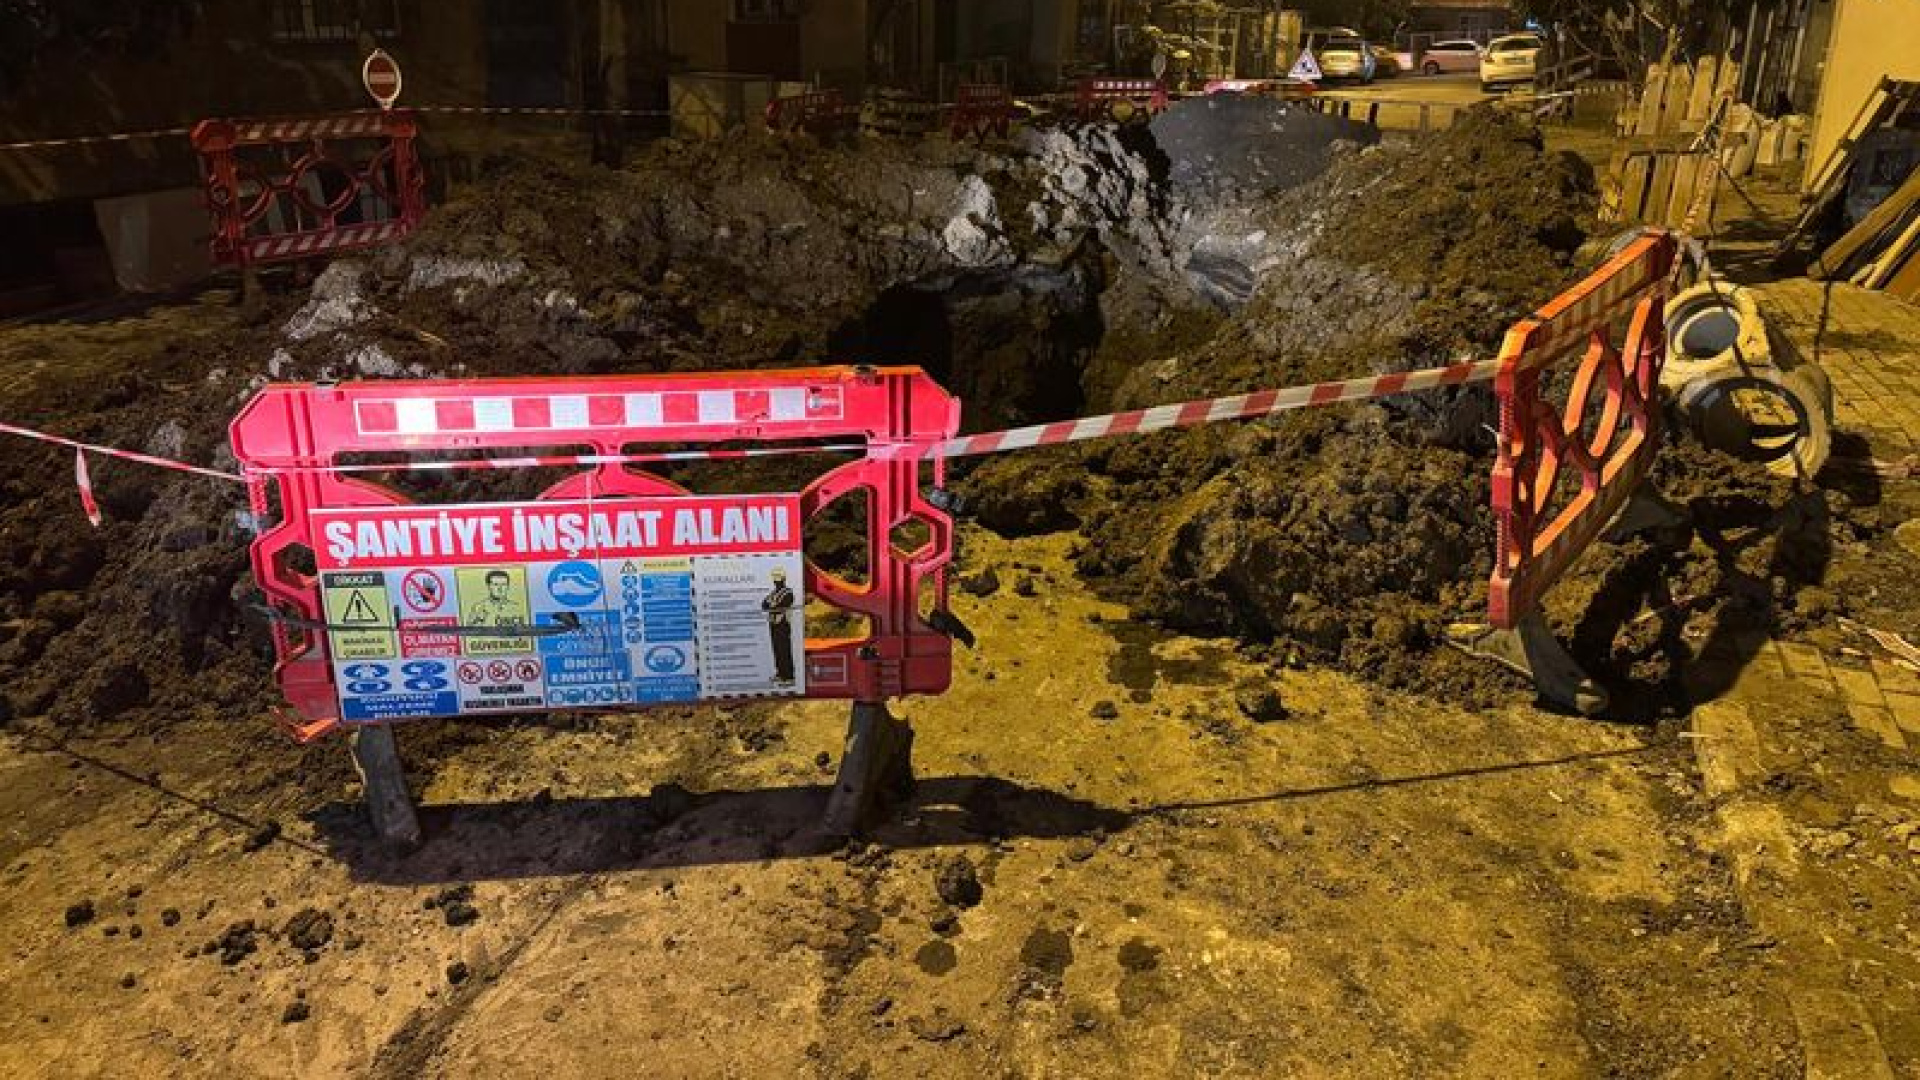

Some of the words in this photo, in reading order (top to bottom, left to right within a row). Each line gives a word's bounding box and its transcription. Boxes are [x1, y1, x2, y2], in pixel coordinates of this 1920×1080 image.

[324, 512, 502, 566] ŞANTİYE
[513, 508, 662, 558] İNŞAAT
[673, 506, 789, 545] ALANI
